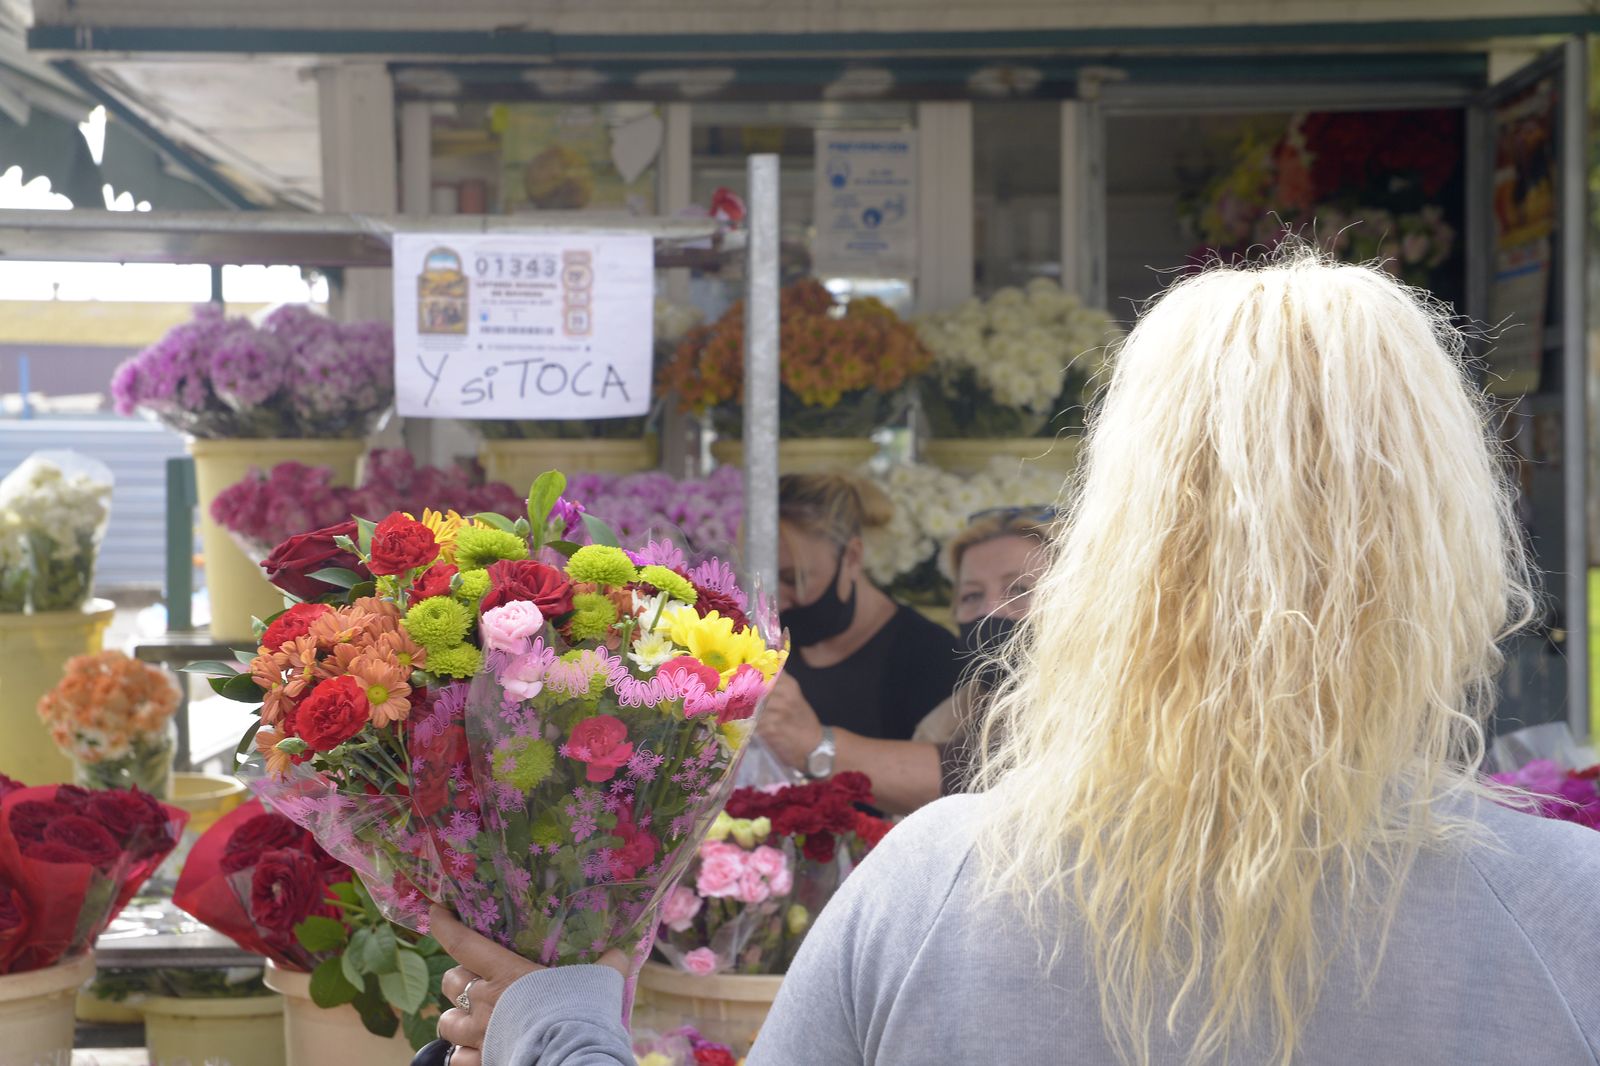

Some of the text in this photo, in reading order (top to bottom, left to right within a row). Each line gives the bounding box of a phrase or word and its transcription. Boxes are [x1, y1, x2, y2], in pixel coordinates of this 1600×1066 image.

[475, 256, 557, 278] 01343
[417, 353, 449, 407] Y
[503, 357, 630, 403] TOCA
